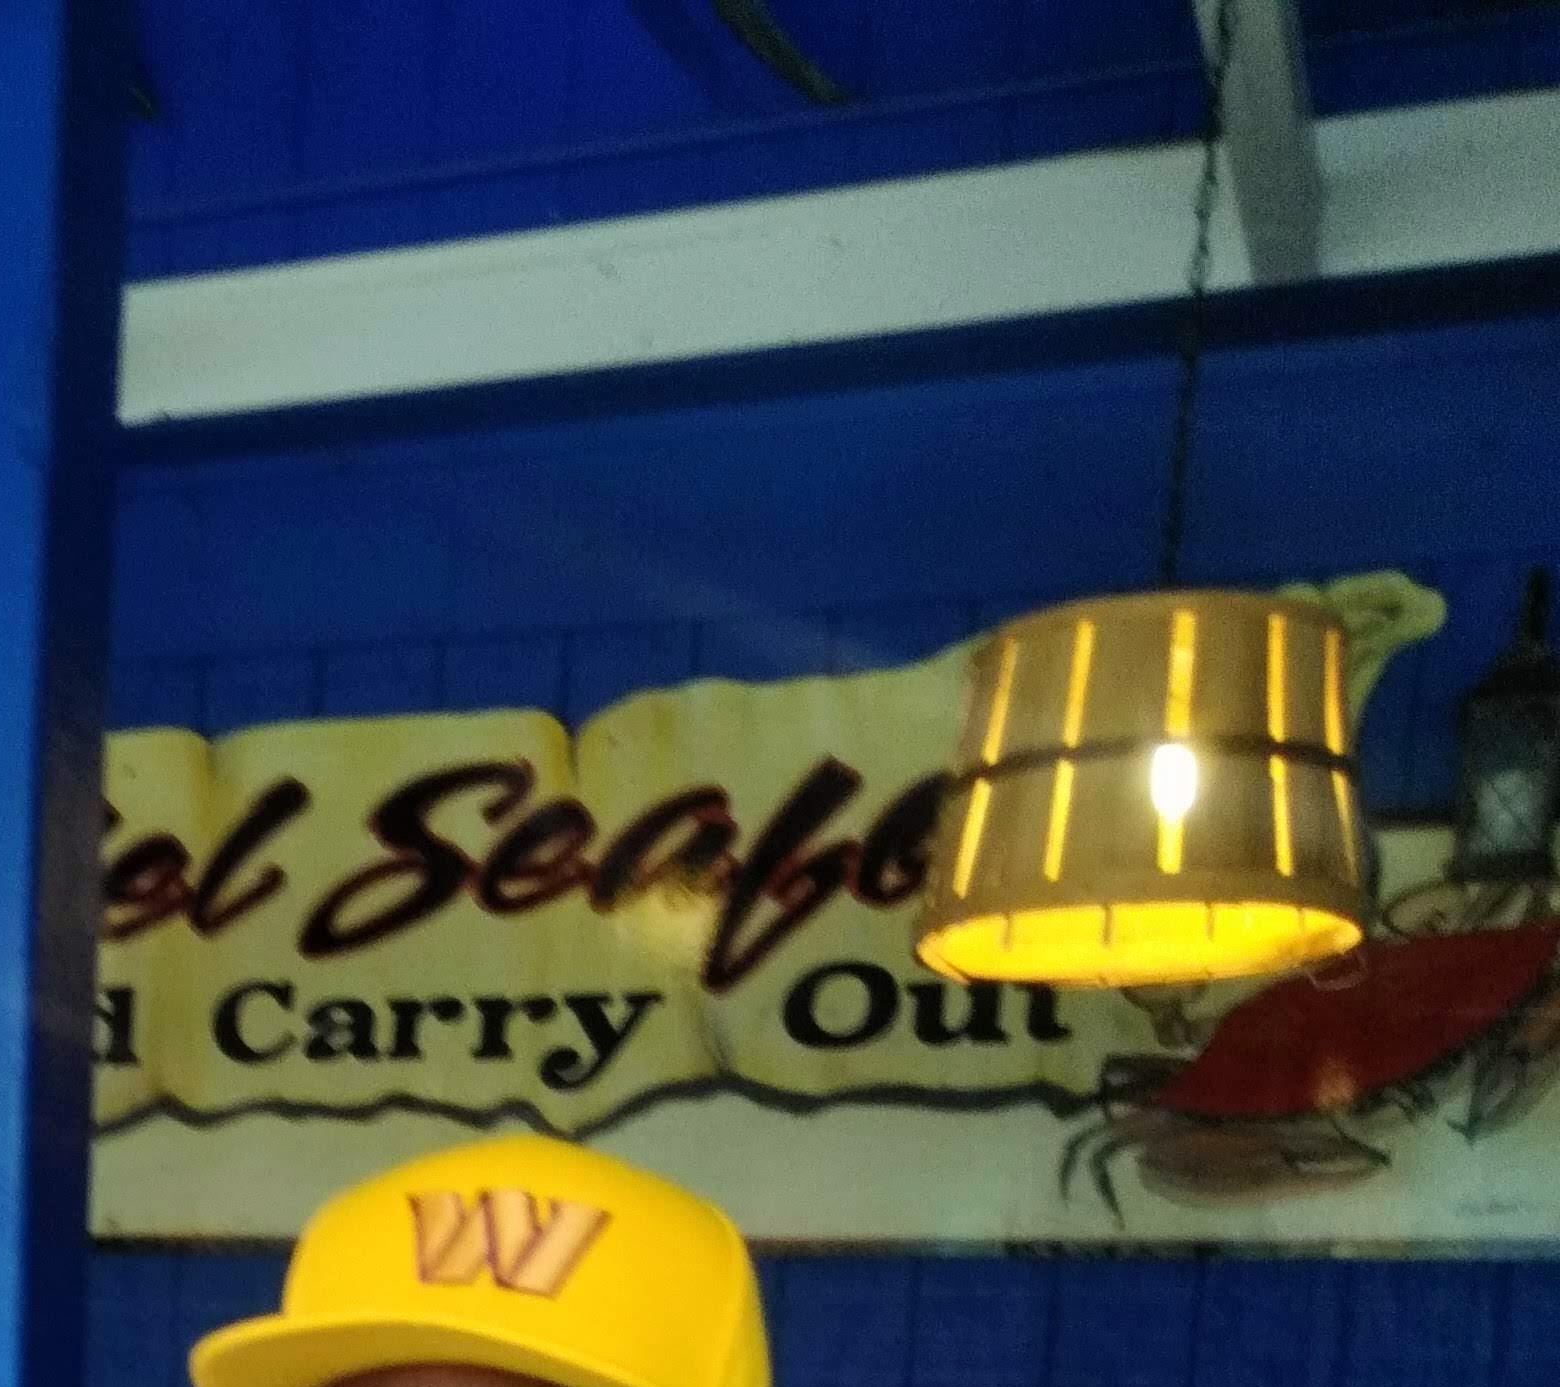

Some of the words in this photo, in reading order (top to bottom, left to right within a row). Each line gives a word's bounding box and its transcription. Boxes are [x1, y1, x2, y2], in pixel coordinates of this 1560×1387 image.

[299, 755, 957, 994] Seafo
[211, 979, 664, 1091] Carry
[780, 960, 1073, 1051] Out
